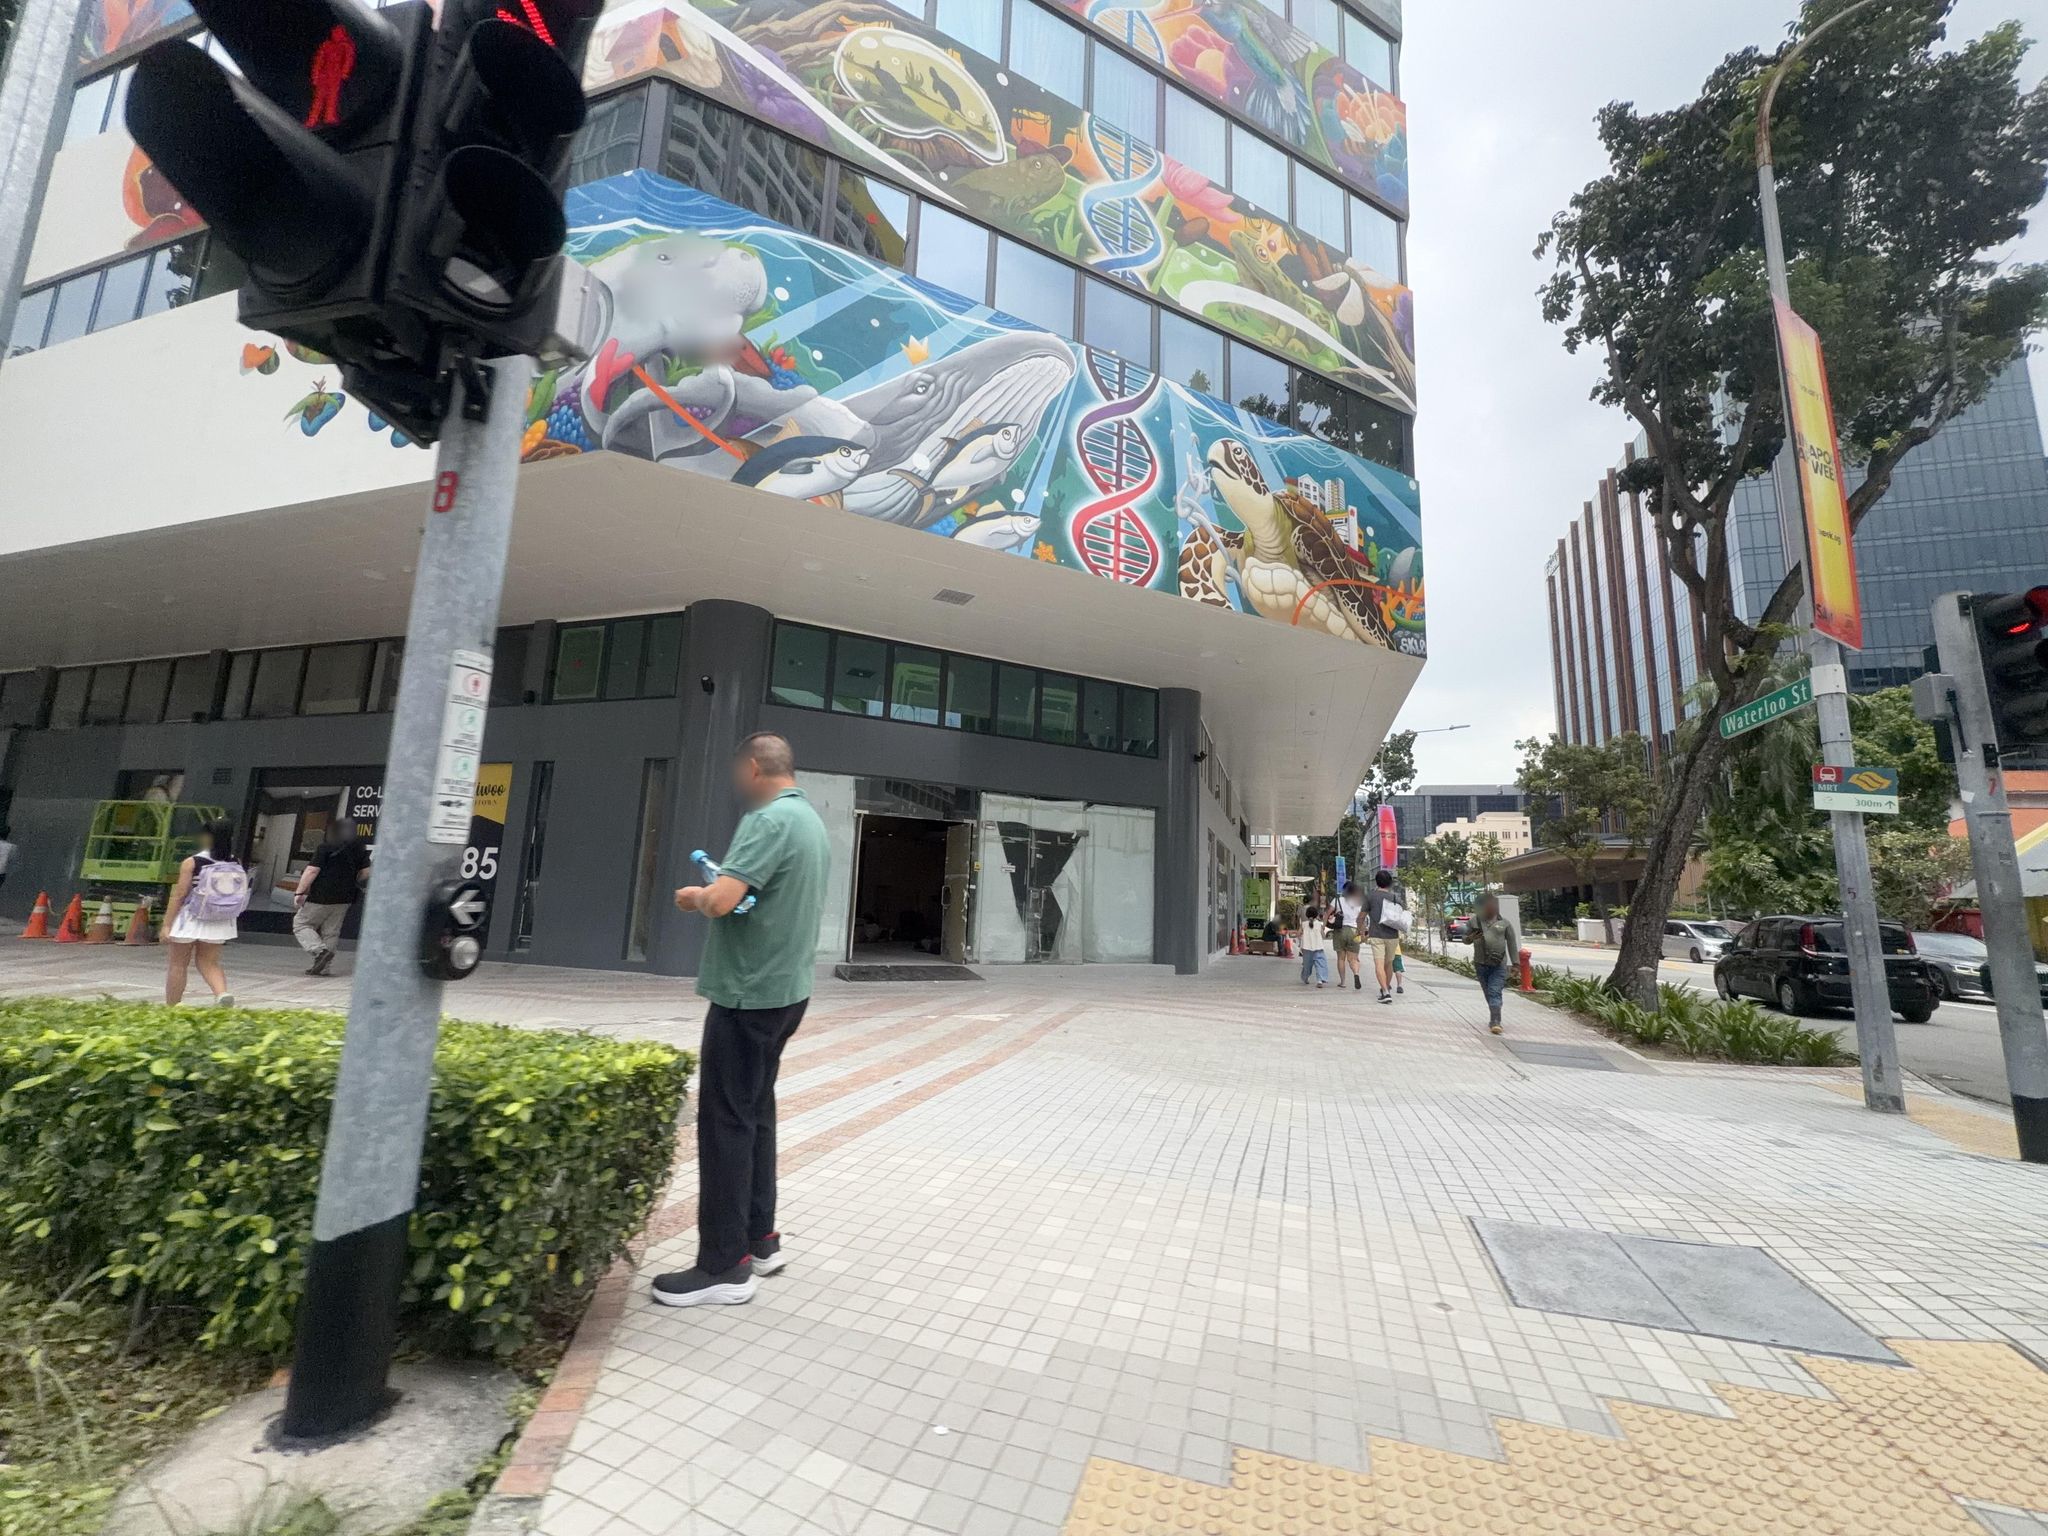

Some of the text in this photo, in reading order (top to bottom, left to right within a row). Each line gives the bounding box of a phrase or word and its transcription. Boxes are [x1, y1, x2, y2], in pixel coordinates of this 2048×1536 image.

[1811, 460, 1835, 481] WEE
[432, 470, 460, 513] 8
[1725, 683, 1808, 734] Waterloo St
[356, 786, 384, 799] CO-L
[1817, 783, 1839, 793] MRT
[1855, 798, 1883, 808] 300m
[352, 804, 383, 818] SERV
